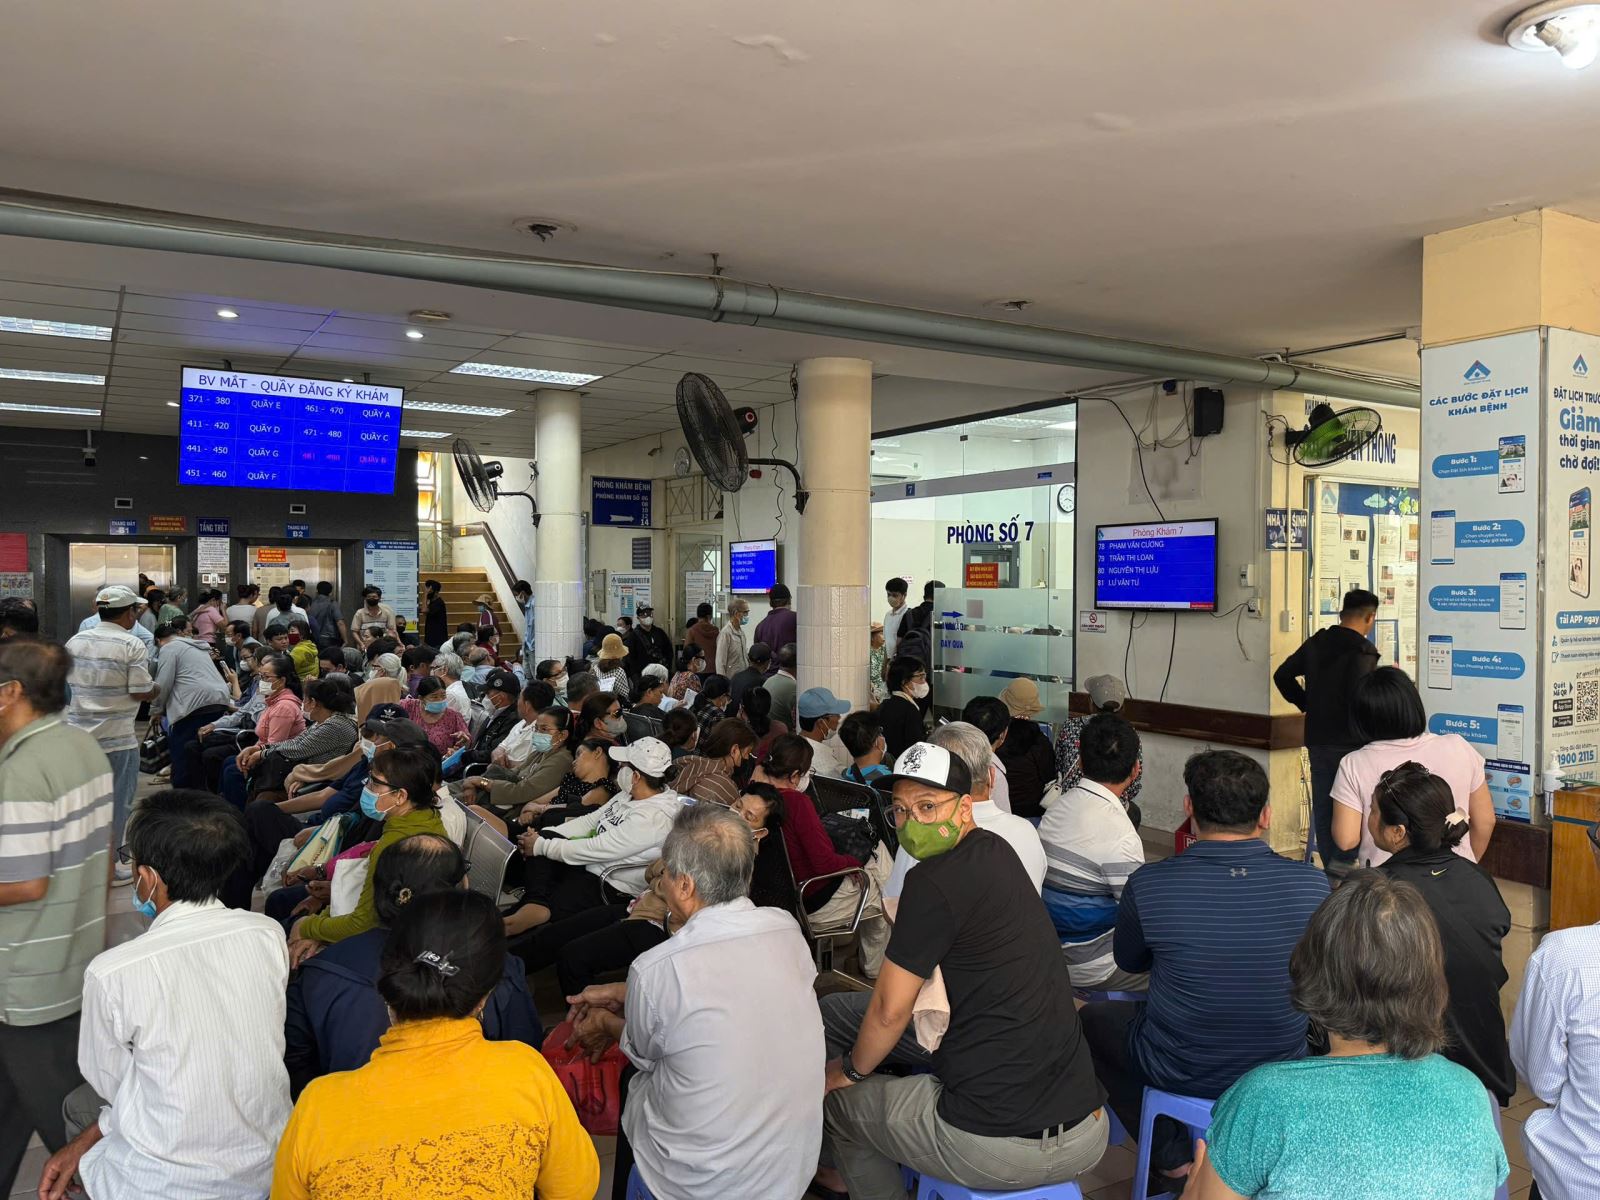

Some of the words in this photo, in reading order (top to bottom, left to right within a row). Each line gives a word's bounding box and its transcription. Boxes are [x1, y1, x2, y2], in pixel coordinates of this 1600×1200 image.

[199, 375, 216, 386] BV
[220, 374, 248, 388] MẮT
[260, 378, 295, 394] QUẦY
[299, 382, 333, 396] ĐĂNG
[337, 386, 352, 398] KÝ
[356, 388, 389, 402] KHÁM
[1554, 386, 1567, 402] ĐẶT
[1568, 390, 1584, 403] LỊCH
[188, 394, 204, 402] 371
[216, 396, 230, 405] 380
[1430, 396, 1448, 406] CÁC
[1451, 392, 1478, 403] BƯỚC
[1481, 388, 1502, 400] ĐẶT
[1504, 386, 1528, 398] LỊCH
[304, 404, 318, 412] 461
[330, 406, 344, 414] 470
[1448, 406, 1476, 416] KHÁM
[1480, 402, 1508, 414] BỆNH
[188, 420, 202, 428] 411
[214, 422, 230, 430] 420
[1560, 406, 1600, 433] Giảm
[1560, 434, 1578, 448] thời
[1580, 435, 1600, 451] gian
[1560, 454, 1578, 469] chờ
[1581, 456, 1600, 474] đợi!
[594, 480, 614, 488] PHÒNG
[616, 481, 634, 490] KHÁM
[634, 482, 650, 492] BỆNH
[1266, 510, 1280, 526] NHÀ
[947, 520, 994, 544] PHÒNG
[998, 514, 1020, 542] SỐ
[1024, 522, 1034, 541] 7
[1132, 529, 1154, 537] Phòng
[1156, 527, 1176, 535] Khám
[1179, 526, 1183, 535] 7
[1570, 615, 1583, 624] APP
[1584, 616, 1600, 624] ngay
[1446, 720, 1467, 728] Bước
[1469, 720, 1480, 729] 5:
[1558, 752, 1576, 765] 1900
[1579, 750, 1594, 762] 2115
